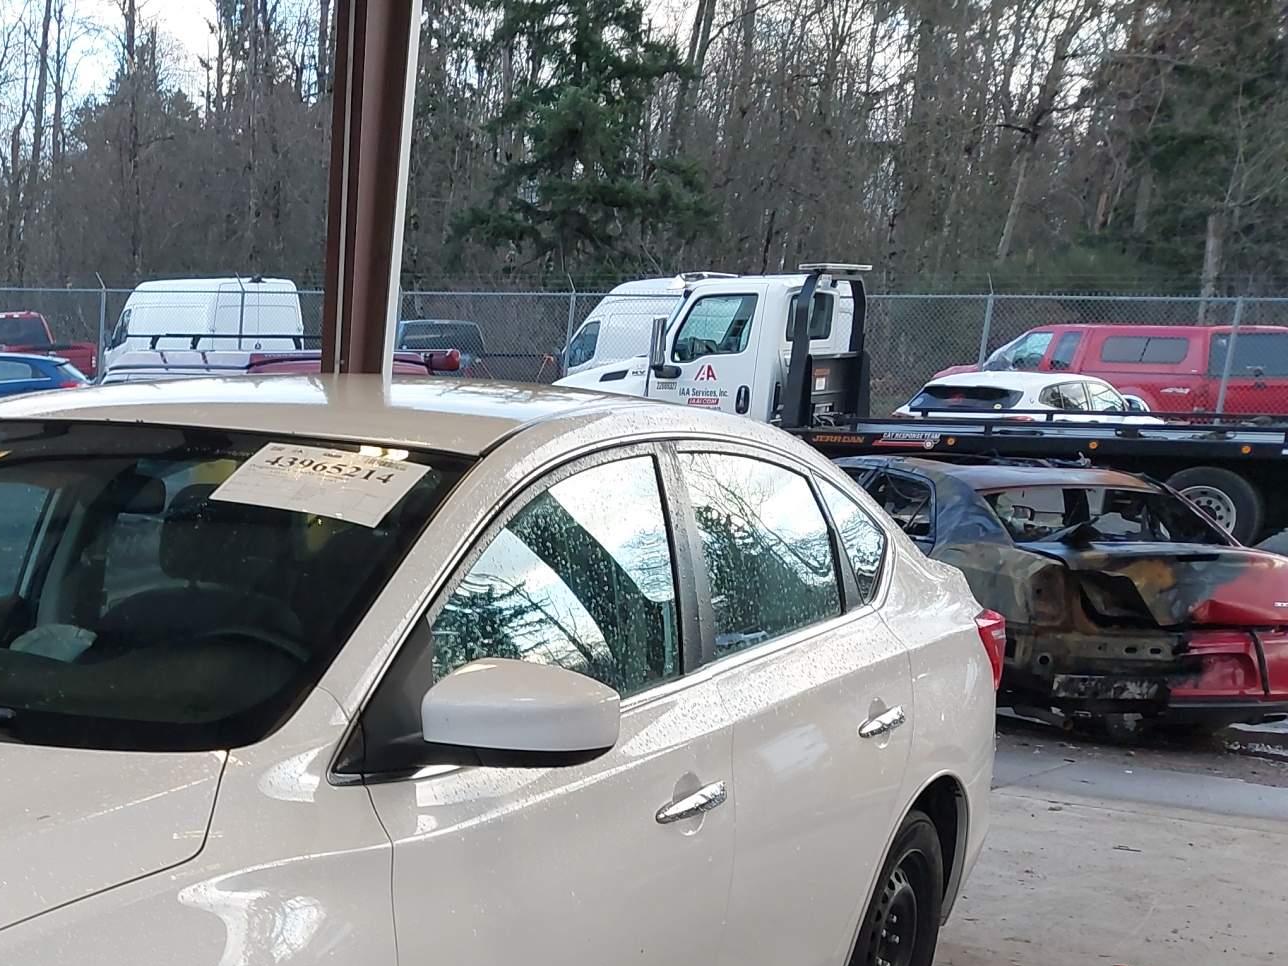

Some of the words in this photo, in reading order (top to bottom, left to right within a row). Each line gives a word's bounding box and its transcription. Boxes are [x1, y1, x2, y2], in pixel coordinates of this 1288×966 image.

[679, 388, 690, 396] IAA
[691, 388, 717, 397] Services,
[883, 432, 894, 440] CAT
[895, 432, 922, 441] RESPONSE
[921, 433, 940, 441] TEAM
[265, 455, 394, 484] 43965214
